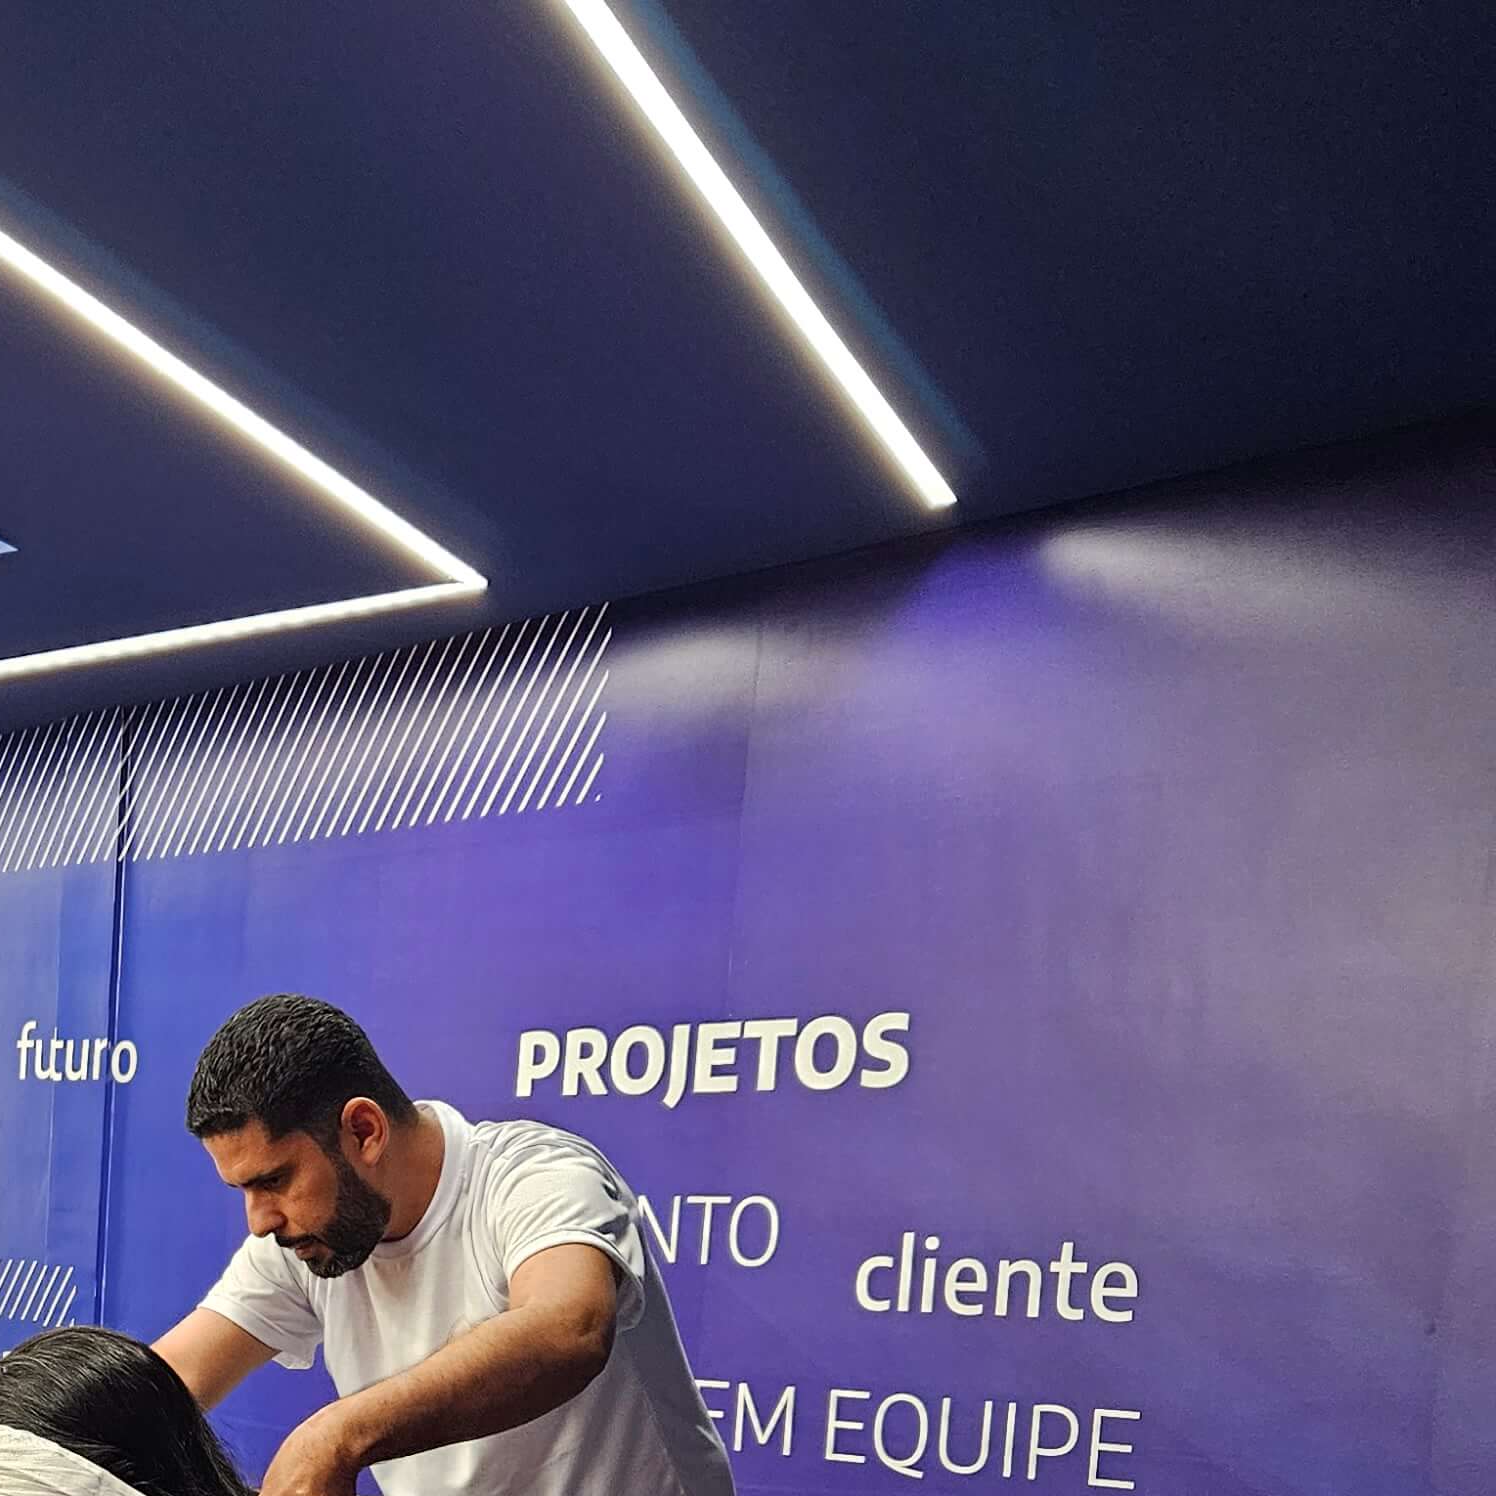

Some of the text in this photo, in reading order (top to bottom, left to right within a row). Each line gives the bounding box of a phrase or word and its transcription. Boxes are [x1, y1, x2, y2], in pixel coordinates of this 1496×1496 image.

[17, 1020, 139, 1084] futuro
[515, 1012, 911, 1109] PROJETOS
[856, 1231, 1139, 1322] cliente
[824, 1389, 1141, 1491] EQUIPE
